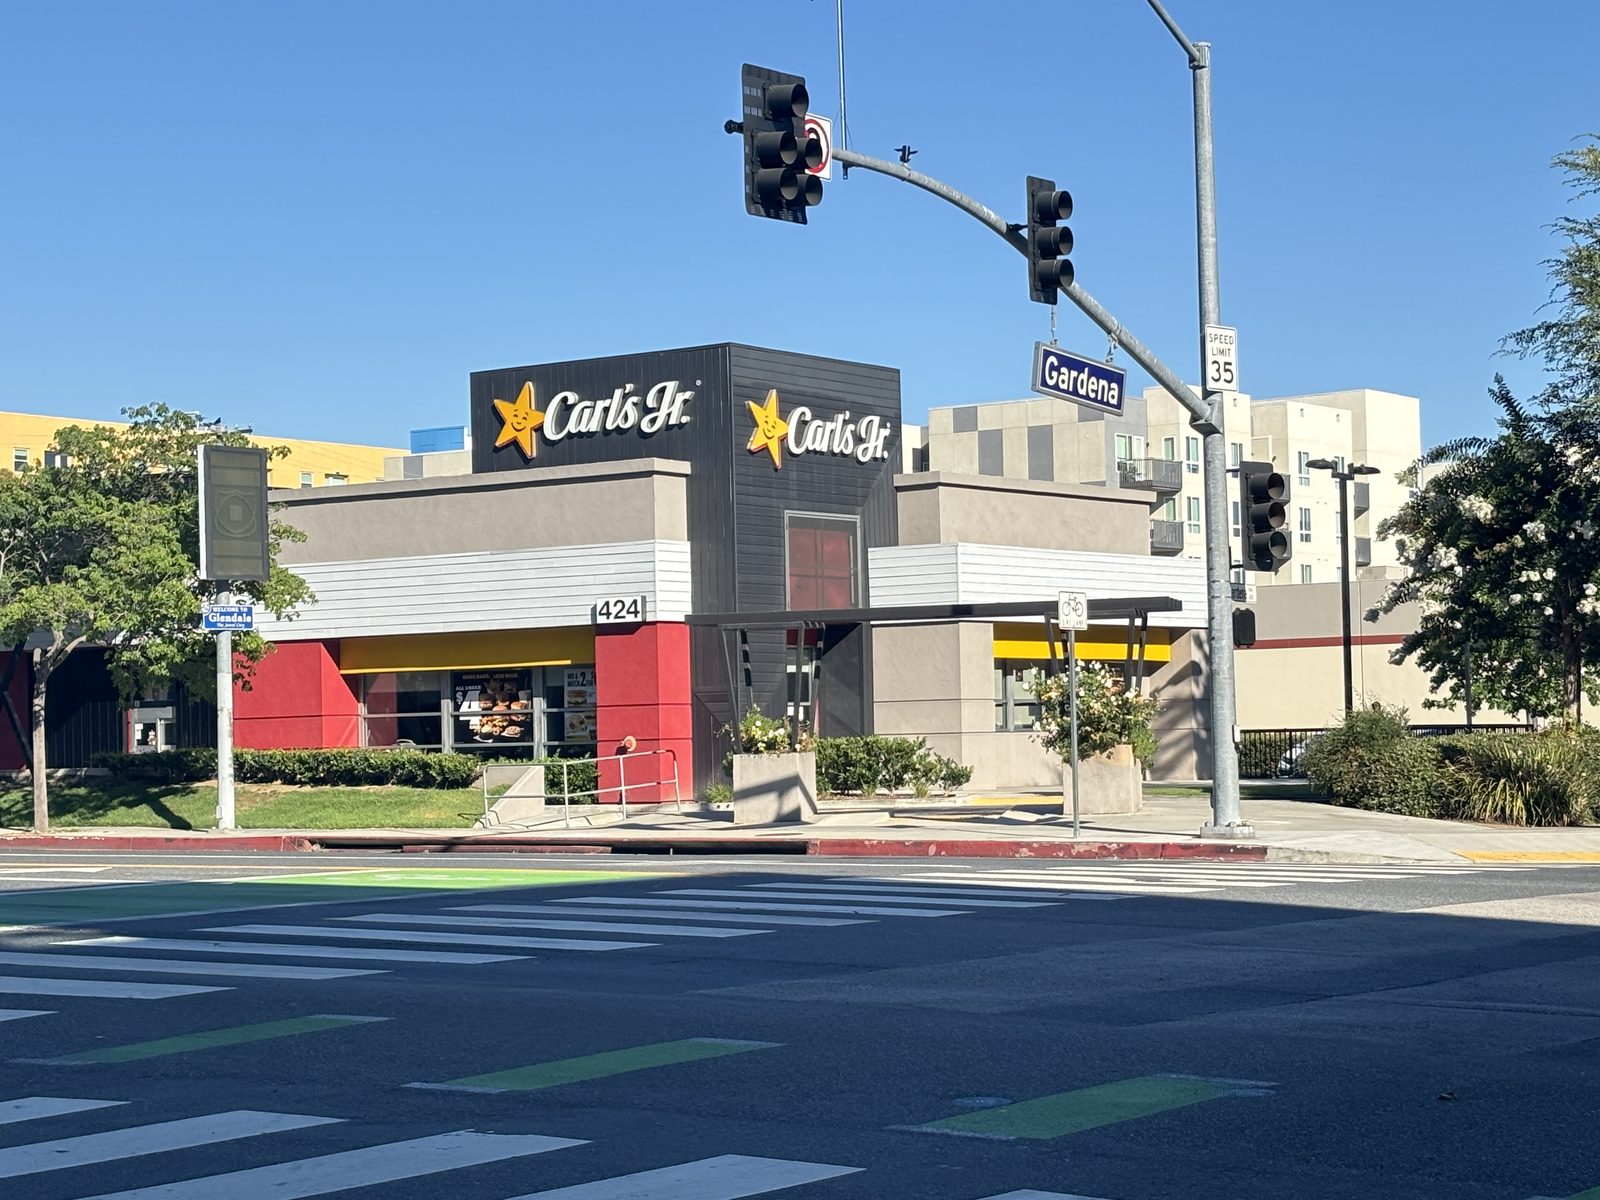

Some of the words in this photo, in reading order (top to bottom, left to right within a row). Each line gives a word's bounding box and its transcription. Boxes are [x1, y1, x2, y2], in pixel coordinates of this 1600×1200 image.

[1209, 333, 1234, 345] SPEED
[1211, 346, 1231, 357] LIMIT
[1044, 355, 1119, 405] Gardena
[1211, 360, 1234, 384] 35
[543, 383, 642, 441] Carl's
[640, 380, 695, 433] Jr.
[787, 406, 856, 455] Carl's
[856, 415, 891, 463] Jr.
[209, 612, 251, 623] Glendale
[598, 599, 640, 620] 424
[580, 671, 586, 687] 2
